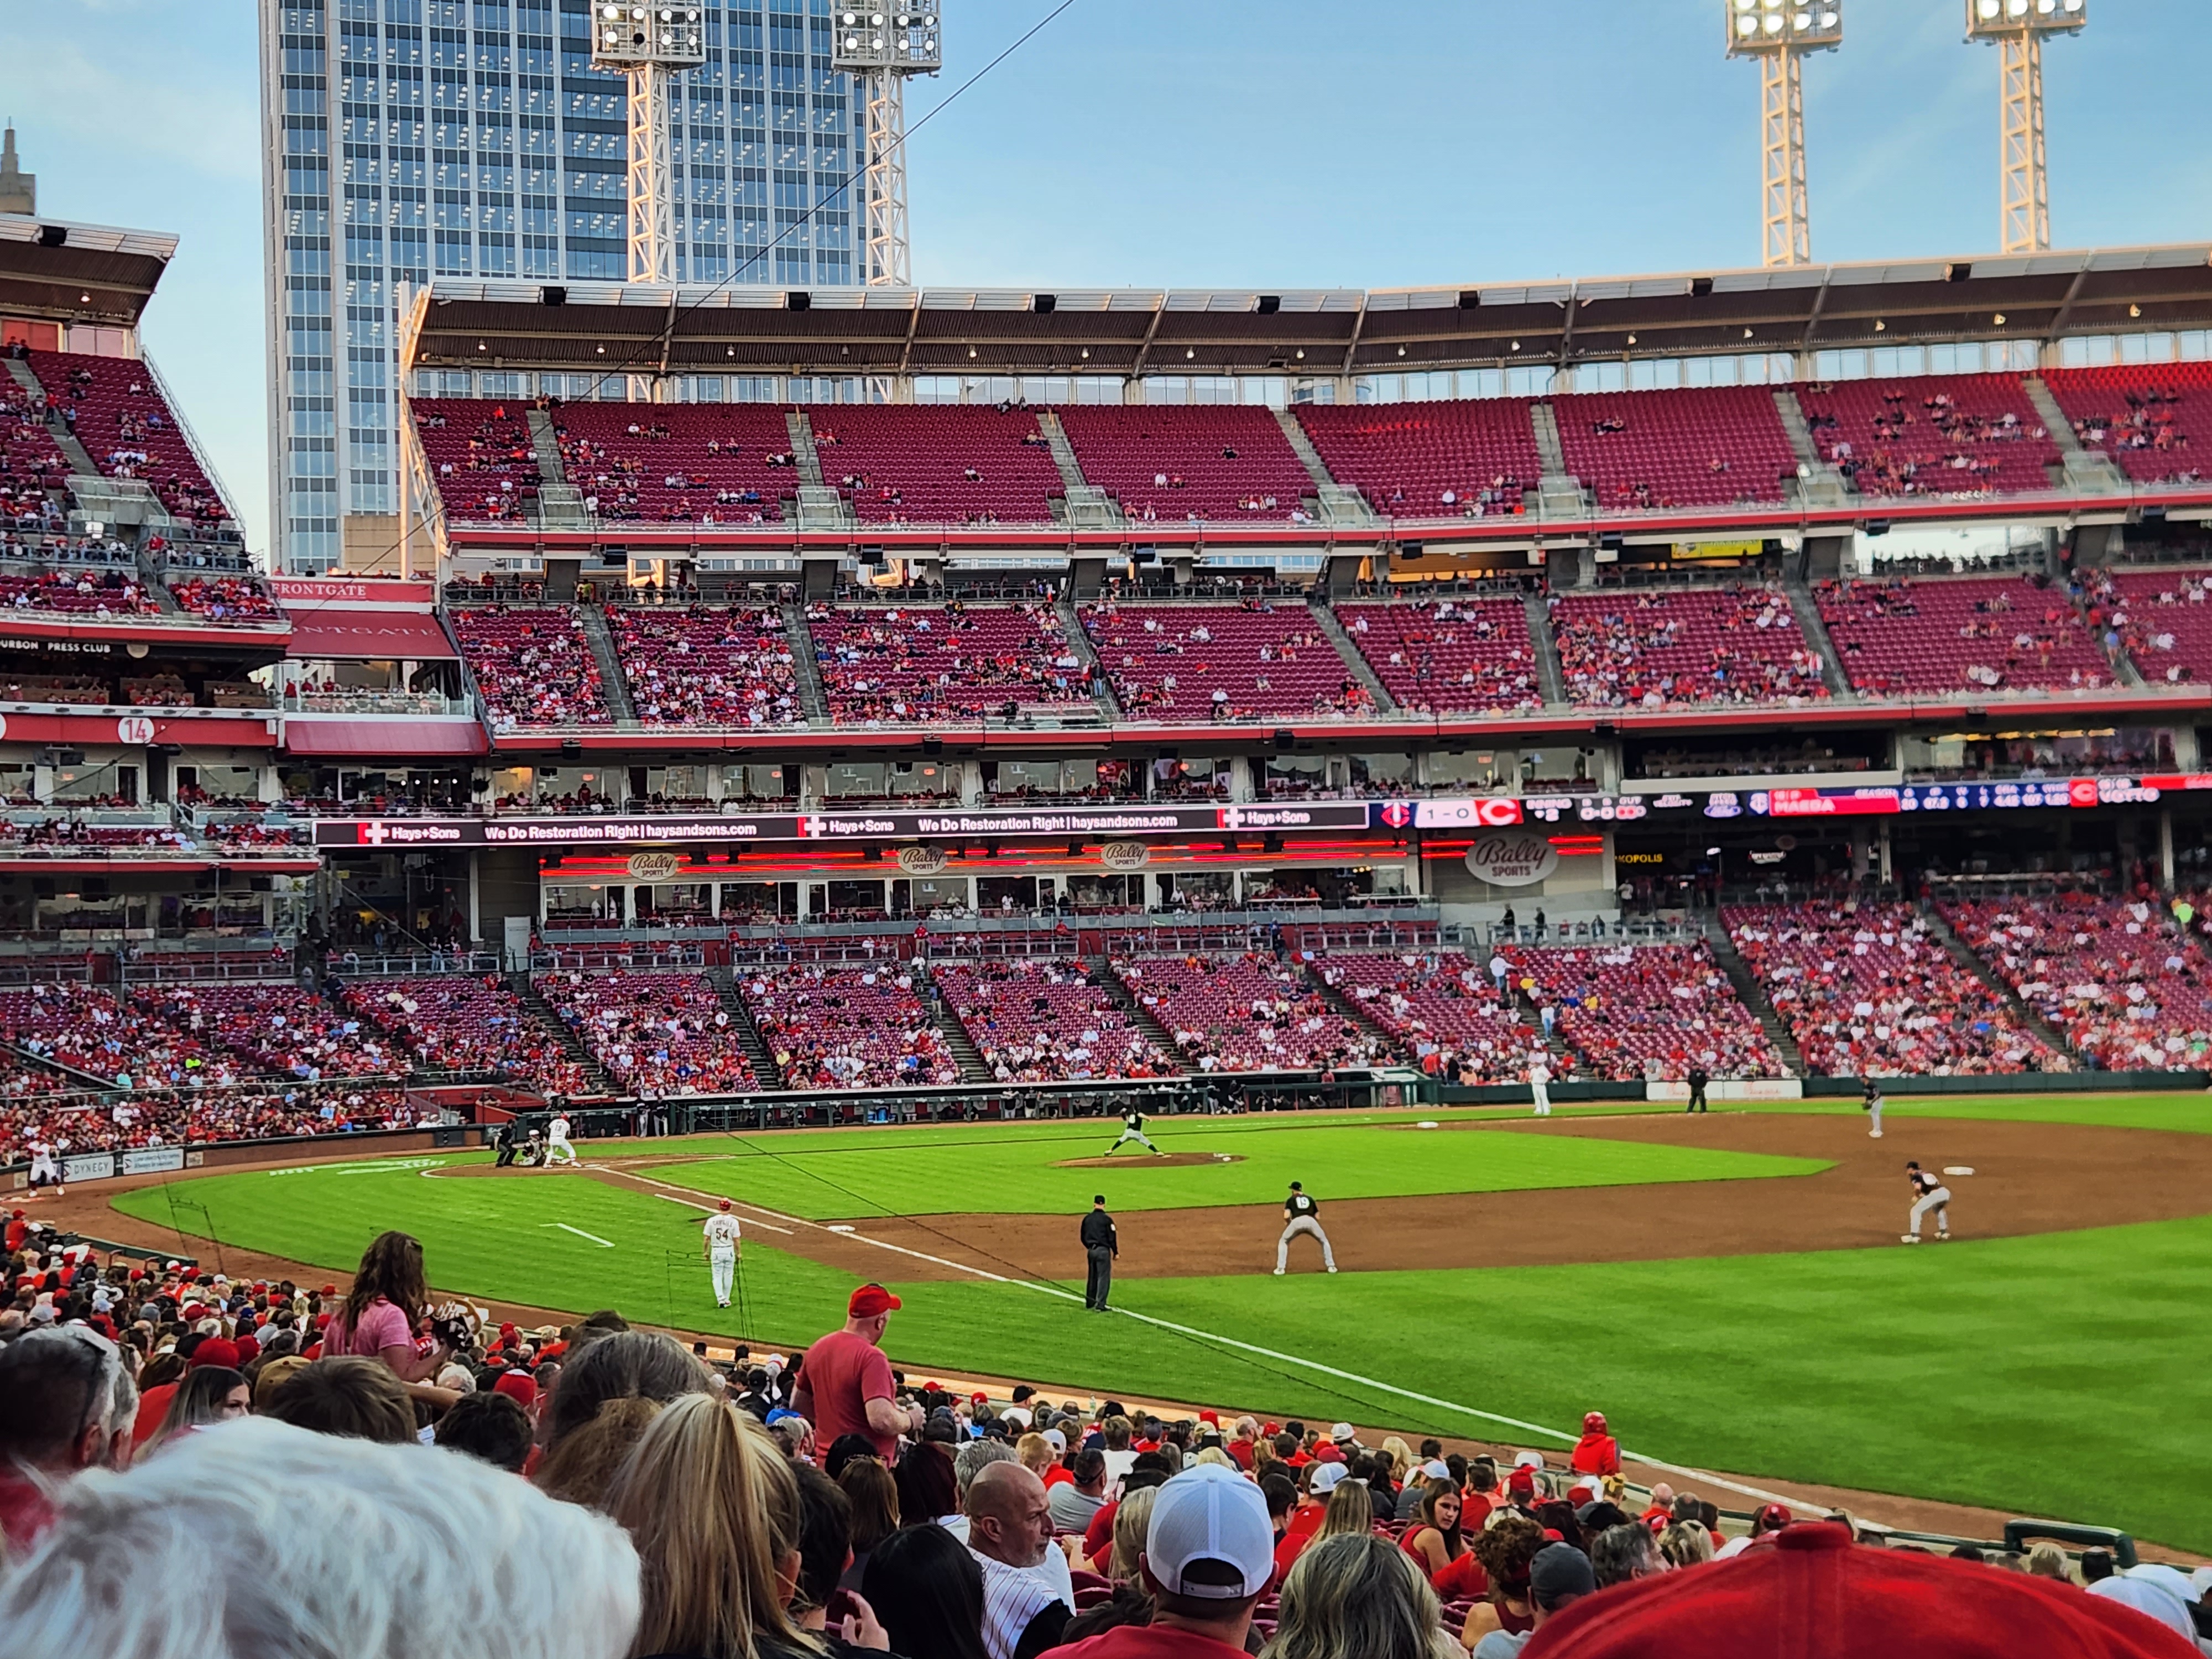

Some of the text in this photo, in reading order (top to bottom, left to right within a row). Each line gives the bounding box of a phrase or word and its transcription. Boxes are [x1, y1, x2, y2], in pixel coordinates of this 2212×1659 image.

[272, 582, 366, 596] FRONTGATE
[0, 639, 111, 653] URBON PRESS CLUB
[124, 719, 147, 741] 14
[1619, 796, 1642, 805] OUT
[2099, 787, 2161, 803] VOTTO
[1526, 798, 1573, 810] INNING
[1247, 811, 1311, 825] Hays+Sons
[1427, 809, 1434, 819] 1
[1457, 808, 1469, 818] 0
[830, 820, 895, 834] Hays+Sons
[918, 819, 939, 831] We
[941, 818, 958, 831] Do
[961, 817, 1030, 831] Restoration
[1032, 816, 1065, 831] Right
[1072, 816, 1178, 830] haysandsons.com
[392, 827, 461, 841] Hays+Sons
[484, 827, 506, 839] We
[508, 827, 527, 839] Do
[529, 826, 603, 839] Restoration
[604, 825, 639, 839] Right
[646, 824, 757, 839] haysandsons.com
[903, 848, 943, 867] Bally
[1106, 844, 1145, 862] Bally
[1475, 838, 1547, 870] Bally
[1615, 853, 1663, 863] KOPOLIS
[633, 854, 675, 872] Bally
[1492, 865, 1531, 877] SPORTS
[74, 1162, 108, 1175] DYNEGY
[1296, 1197, 1310, 1209] 19
[716, 1228, 729, 1240] 54
